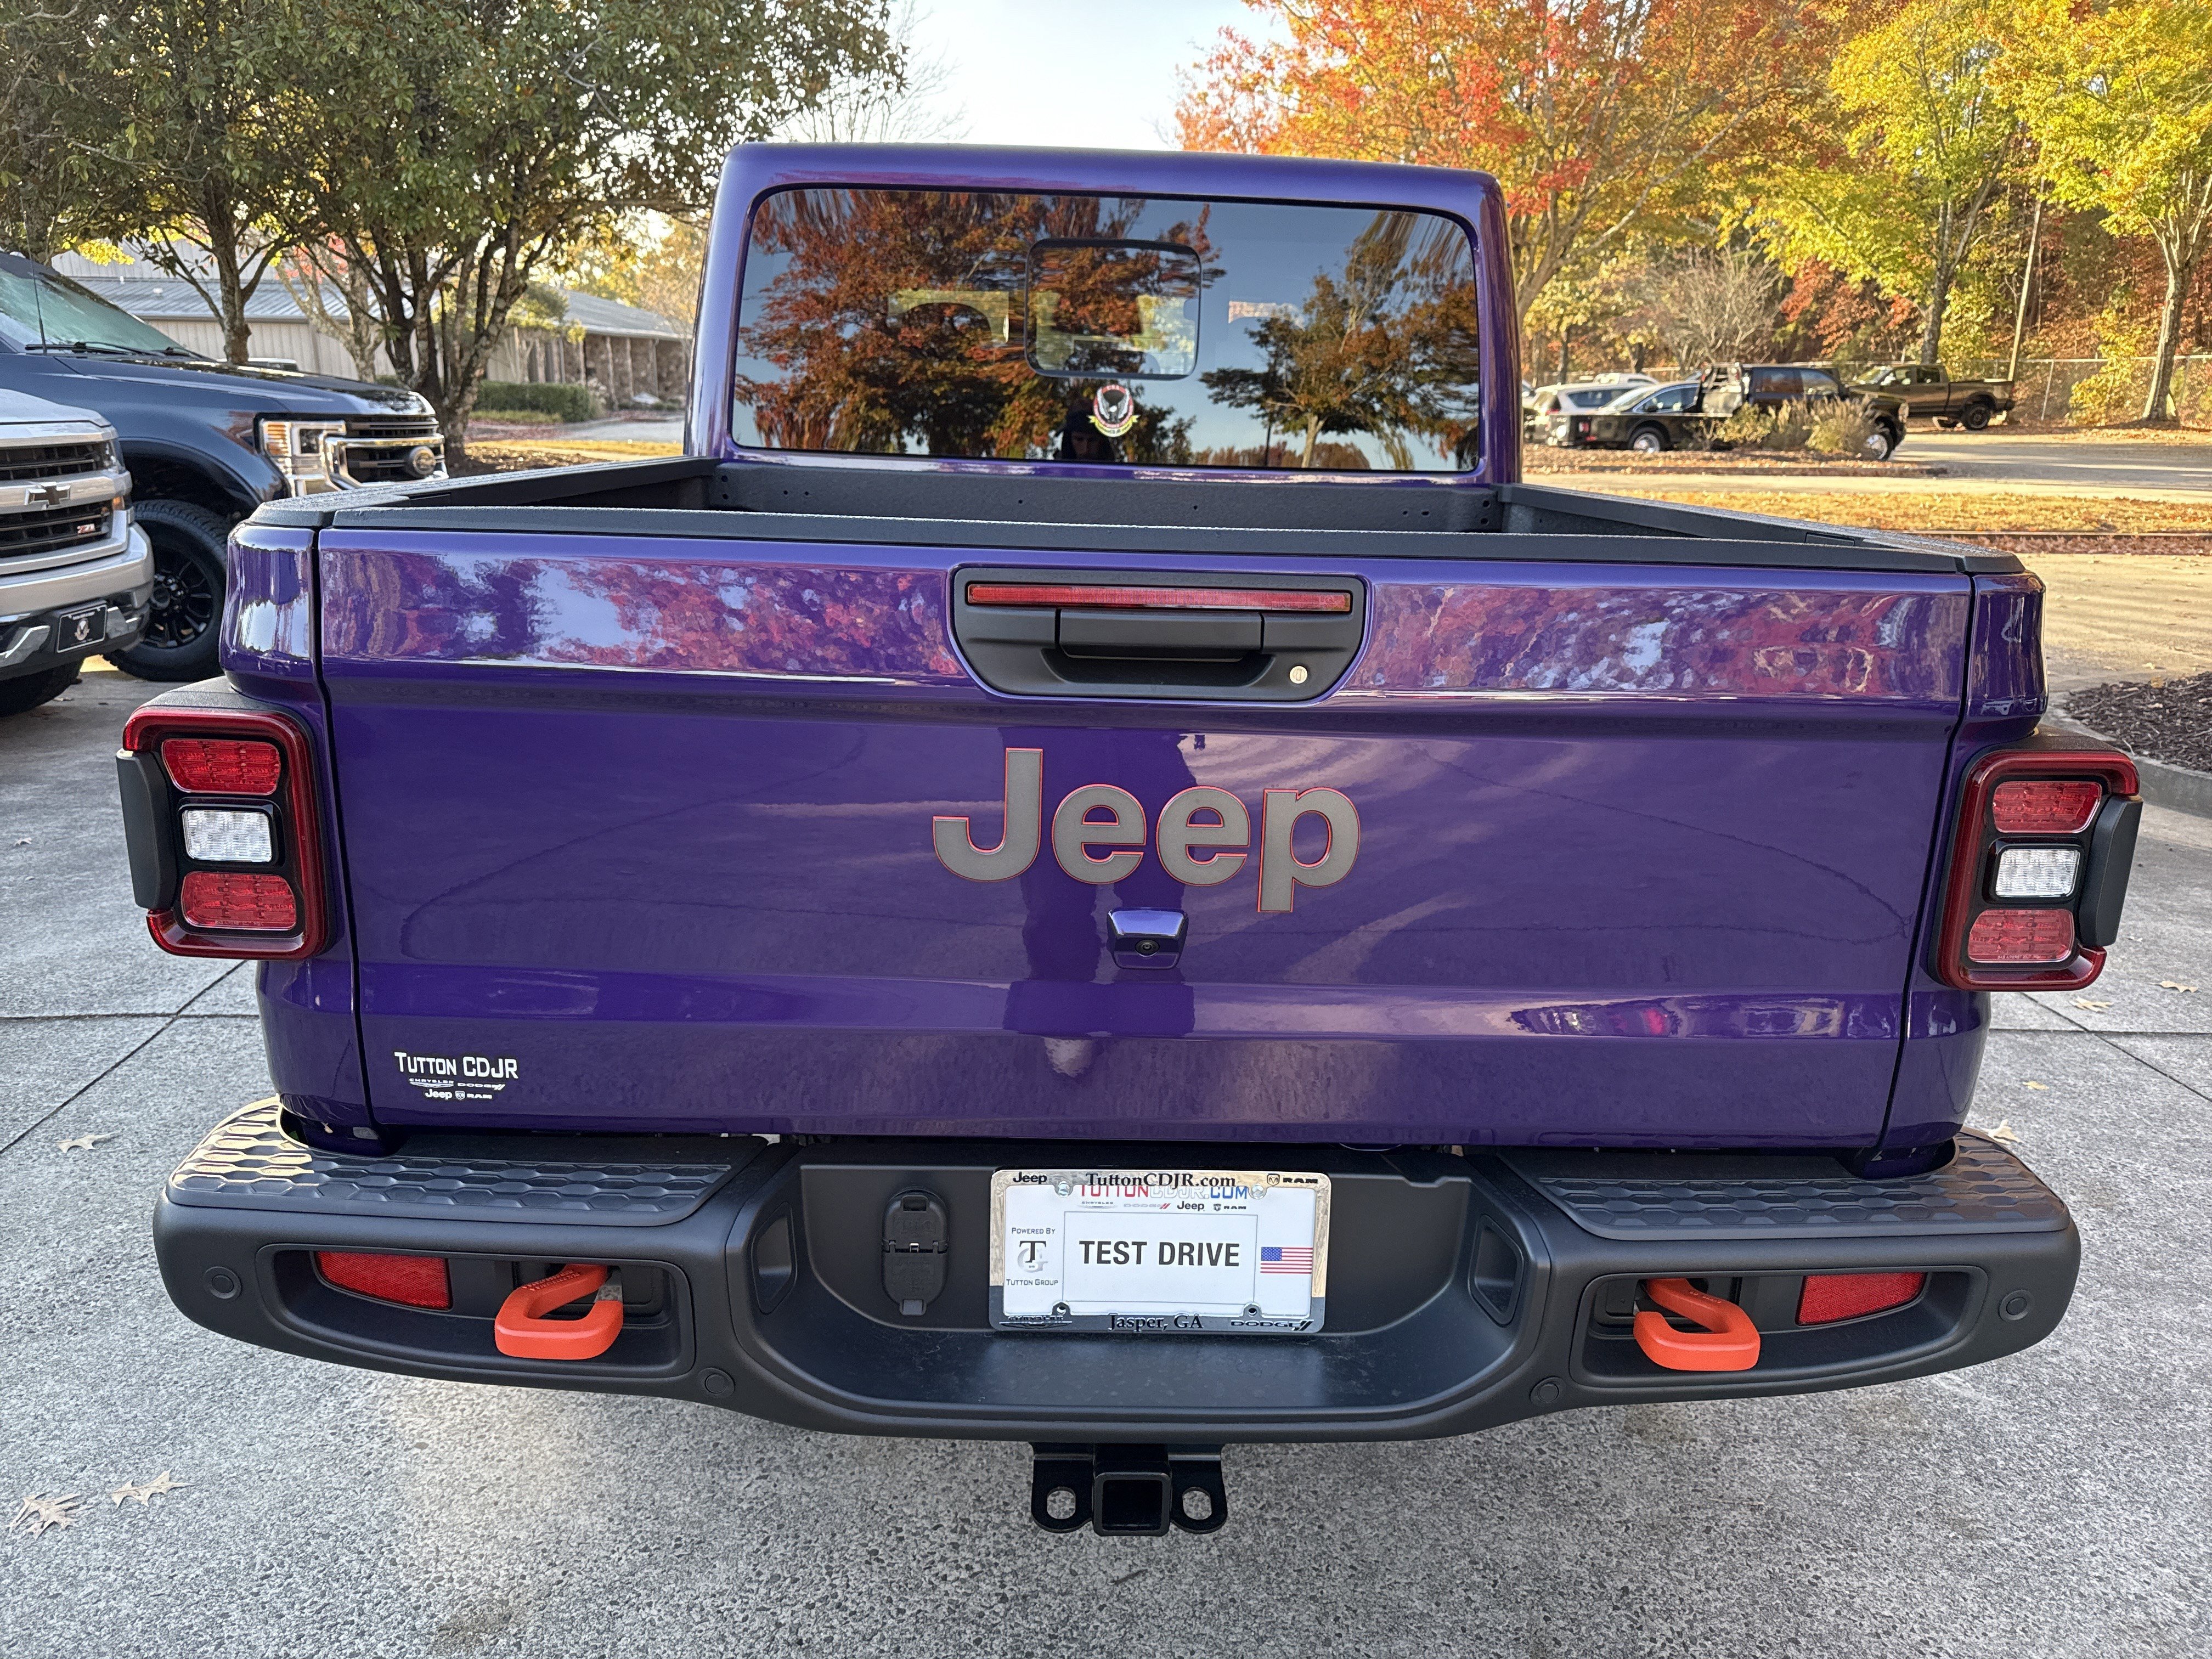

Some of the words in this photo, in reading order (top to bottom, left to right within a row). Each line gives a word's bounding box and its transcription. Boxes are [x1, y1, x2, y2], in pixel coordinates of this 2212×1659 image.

[933, 747, 1361, 912] Jeep
[394, 1052, 457, 1075] TUTTON
[462, 1056, 518, 1079] CDJR
[425, 1088, 453, 1099] Jeep
[1013, 1172, 1047, 1184] Jeep
[1086, 1172, 1235, 1189] TuttonCDJR.com
[1177, 1201, 1205, 1211] Jeep
[1079, 1240, 1147, 1265] TEST
[1159, 1242, 1239, 1266] DRIVE
[1108, 1313, 1169, 1332] Jasper,
[1173, 1313, 1204, 1329] GA
[1231, 1319, 1302, 1328] DODGE
